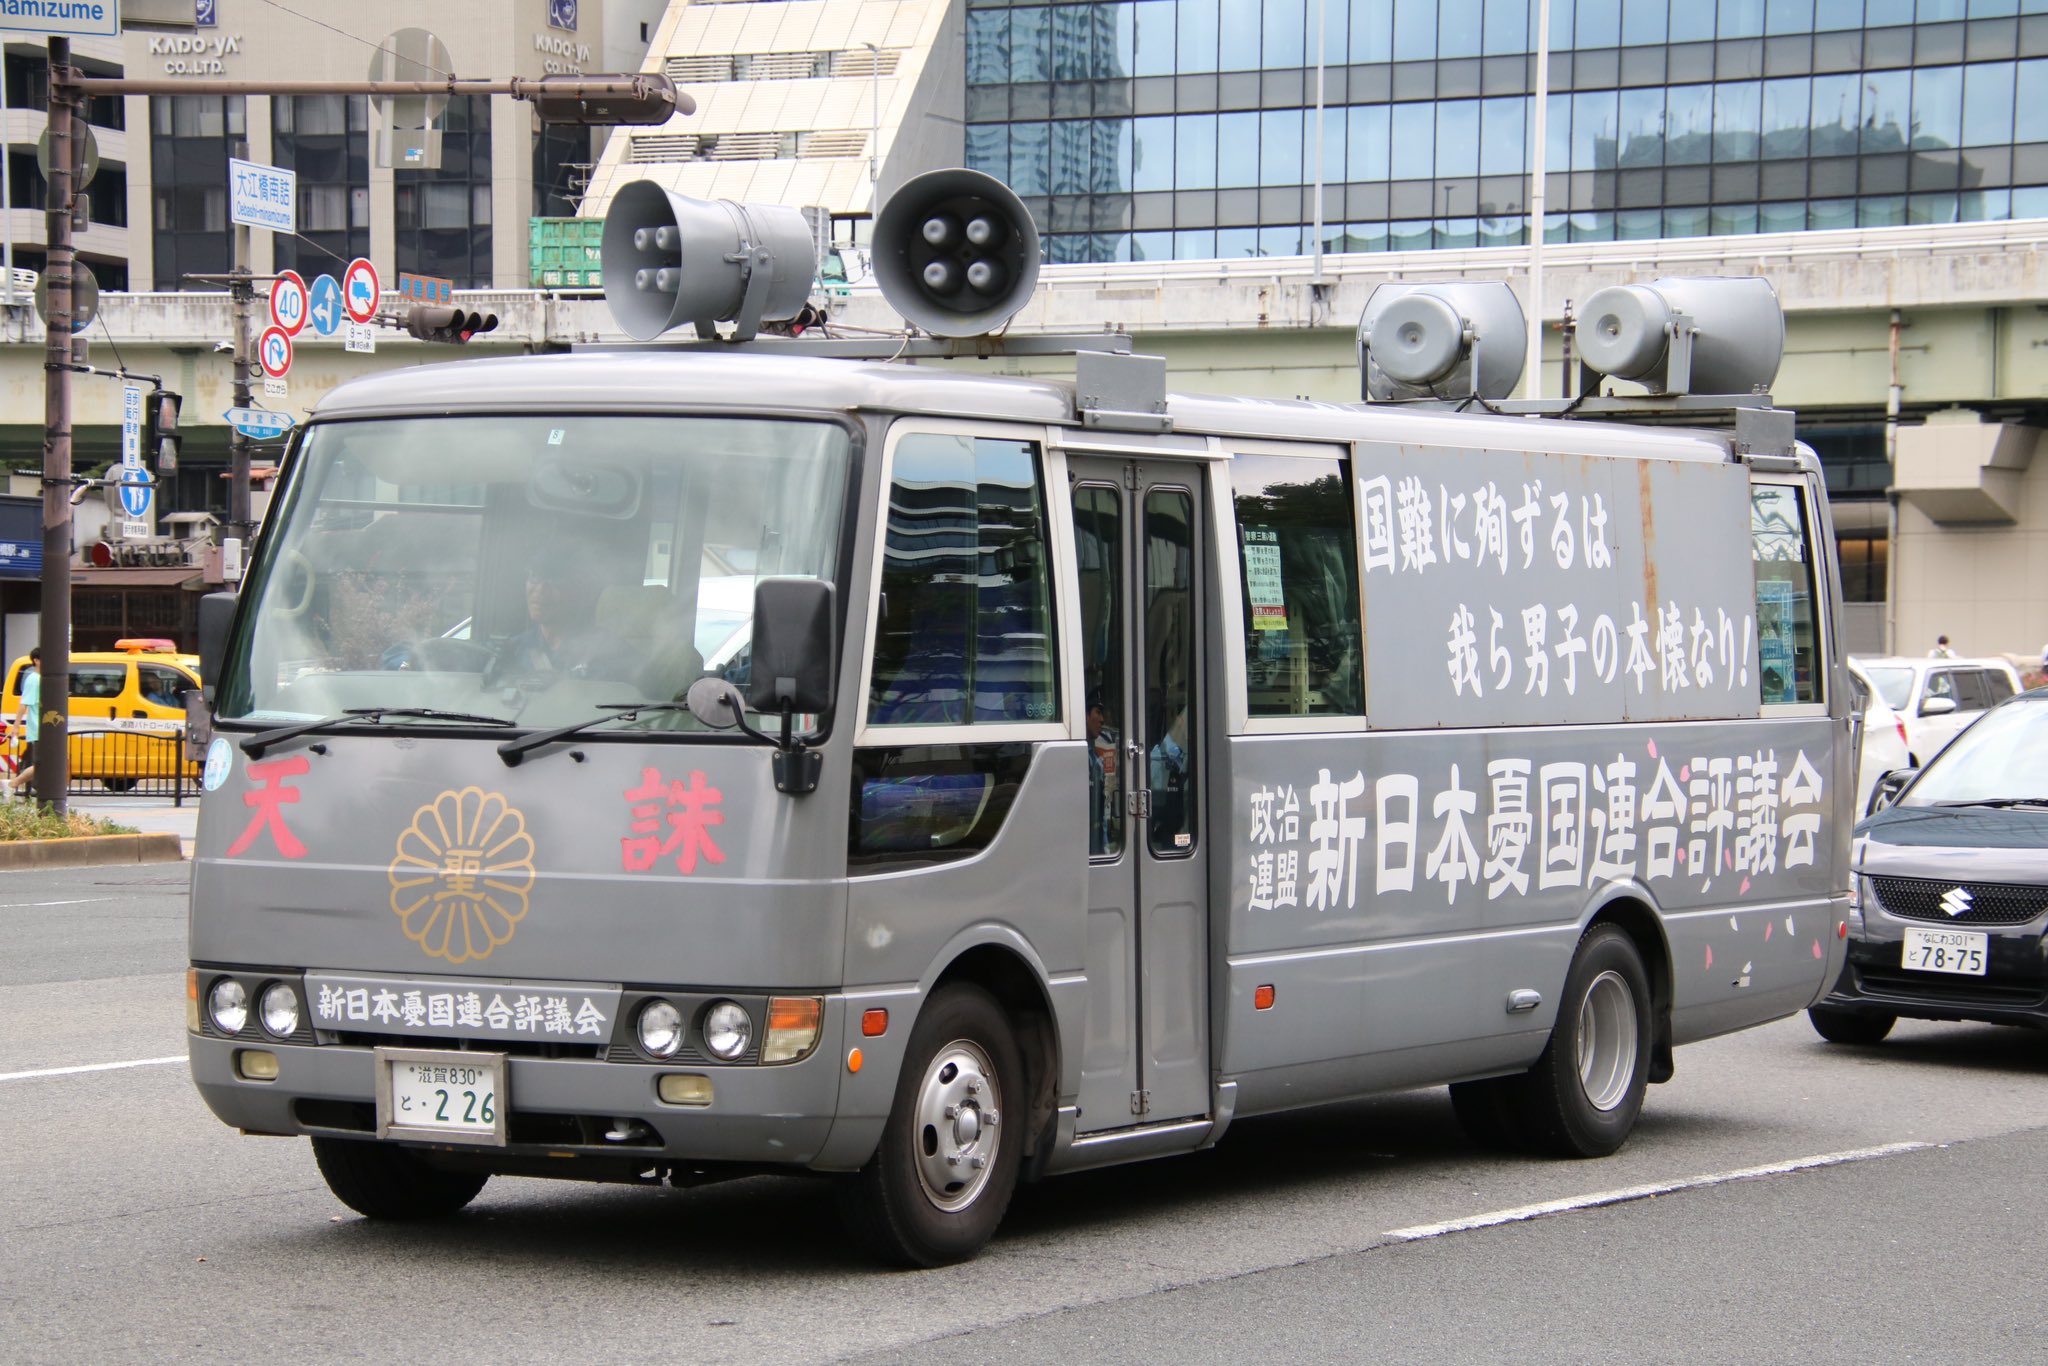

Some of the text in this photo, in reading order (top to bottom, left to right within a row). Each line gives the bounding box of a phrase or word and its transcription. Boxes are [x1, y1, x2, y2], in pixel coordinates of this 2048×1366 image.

[237, 170, 290, 206] 大江橋南詰
[279, 290, 300, 319] 40
[266, 383, 287, 395] ここから
[1359, 475, 1611, 575] 国難に殉ずるは
[1447, 600, 1752, 697] 我ら男子の本懐なり！
[227, 756, 309, 858] 天
[1250, 783, 1300, 844] 政治
[1307, 749, 1823, 911] 新日本憂国連合評議会
[1248, 849, 1299, 912] 連盟
[1909, 947, 1982, 971] と 78-75
[317, 984, 607, 1036] 新日本憂国連合評議会
[401, 1096, 412, 1111] と
